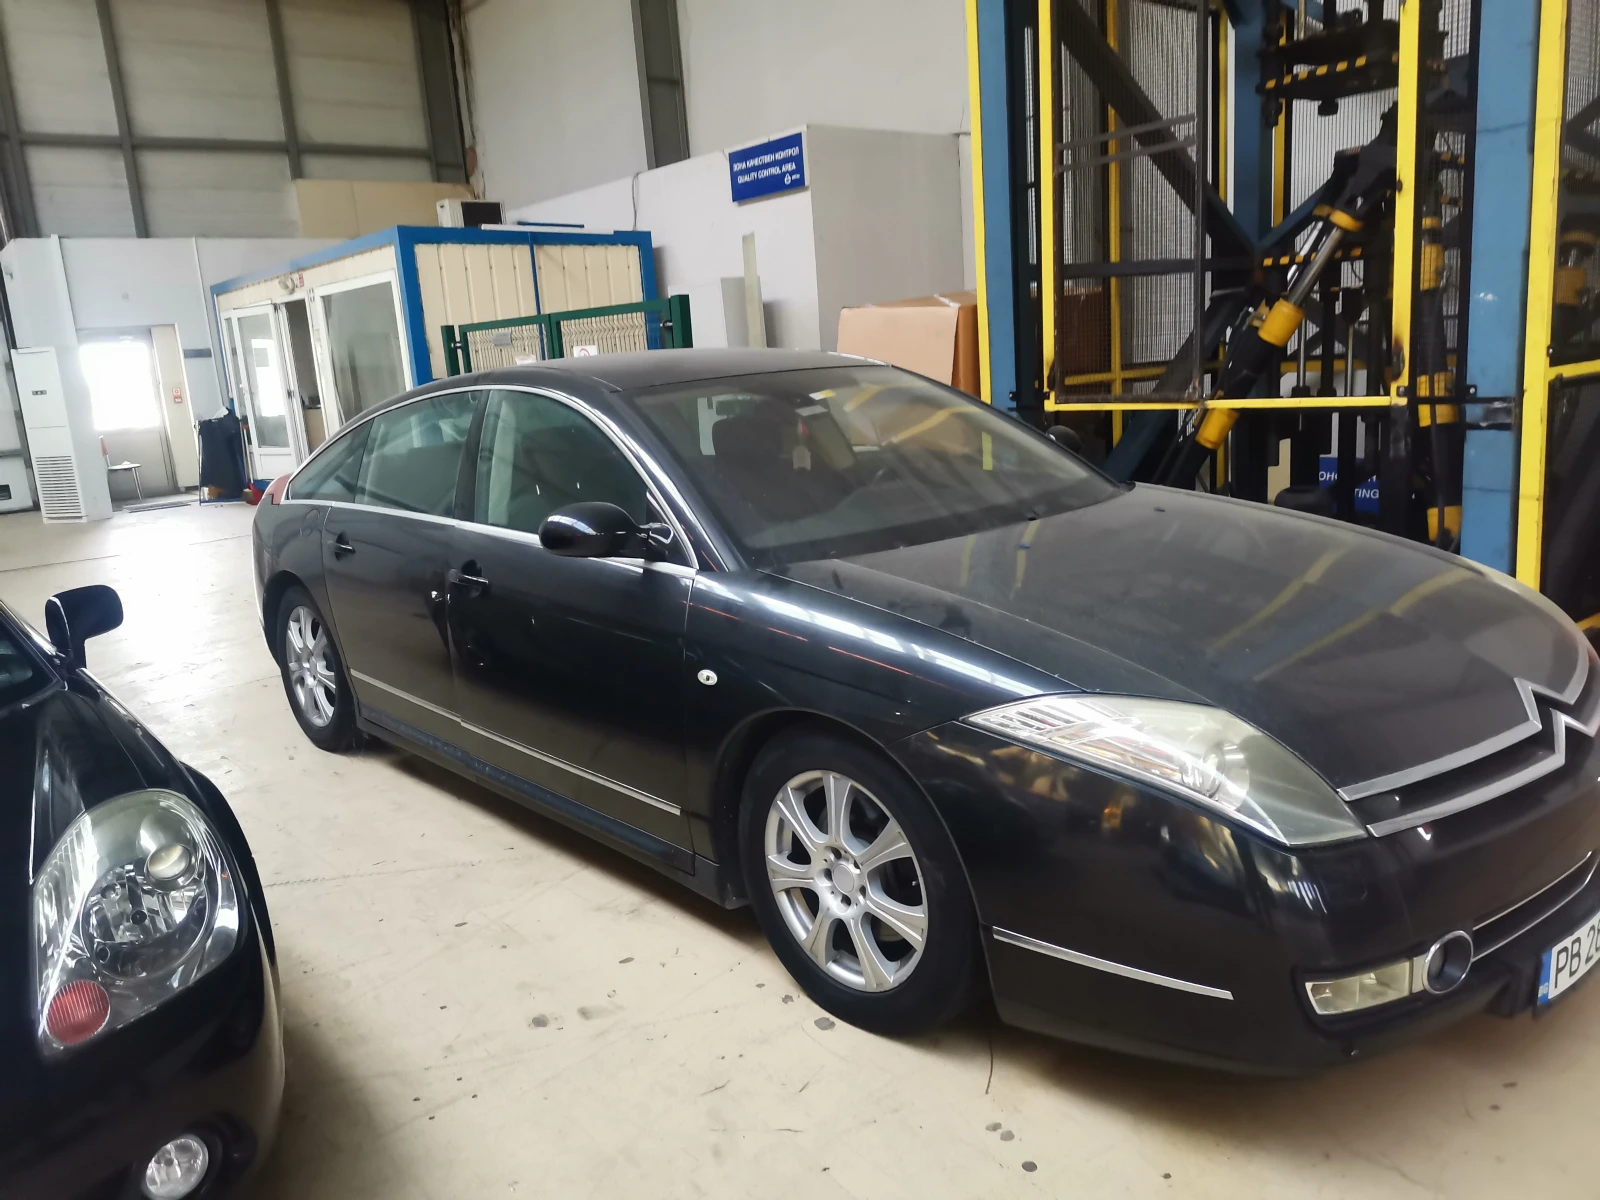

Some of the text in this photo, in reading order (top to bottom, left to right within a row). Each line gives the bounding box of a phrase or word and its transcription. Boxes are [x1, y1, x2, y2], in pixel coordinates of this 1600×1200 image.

[733, 146, 800, 172] ЗОНА КАЧЕСТВЕН КОНТРОЛ
[737, 171, 757, 184] QUALITY
[758, 165, 781, 179] CONTROL
[782, 161, 796, 173] AREA
